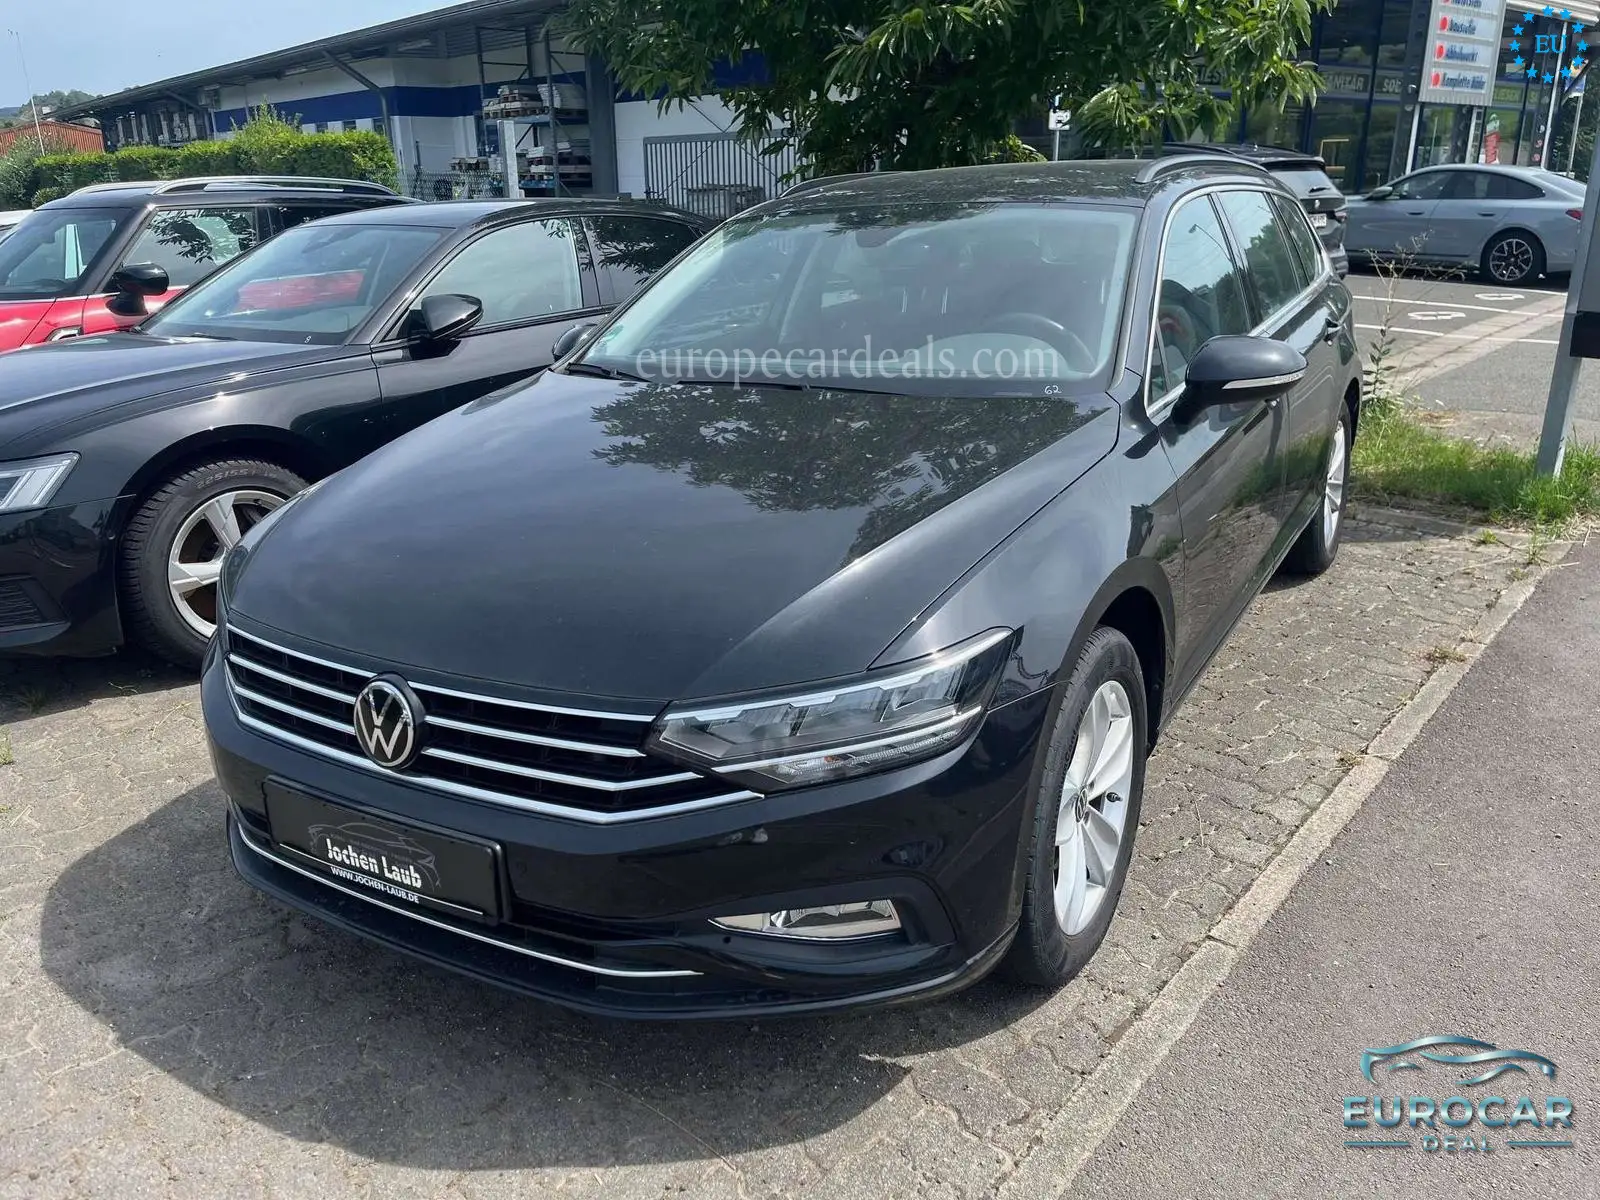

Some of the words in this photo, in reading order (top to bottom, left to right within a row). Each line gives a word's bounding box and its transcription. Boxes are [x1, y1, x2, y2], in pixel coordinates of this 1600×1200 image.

[1044, 384, 1062, 395] 62
[326, 838, 380, 874] Jochen
[381, 855, 422, 889] Laub
[330, 866, 420, 904] WWW.JOCHEN-LAUB.DE
